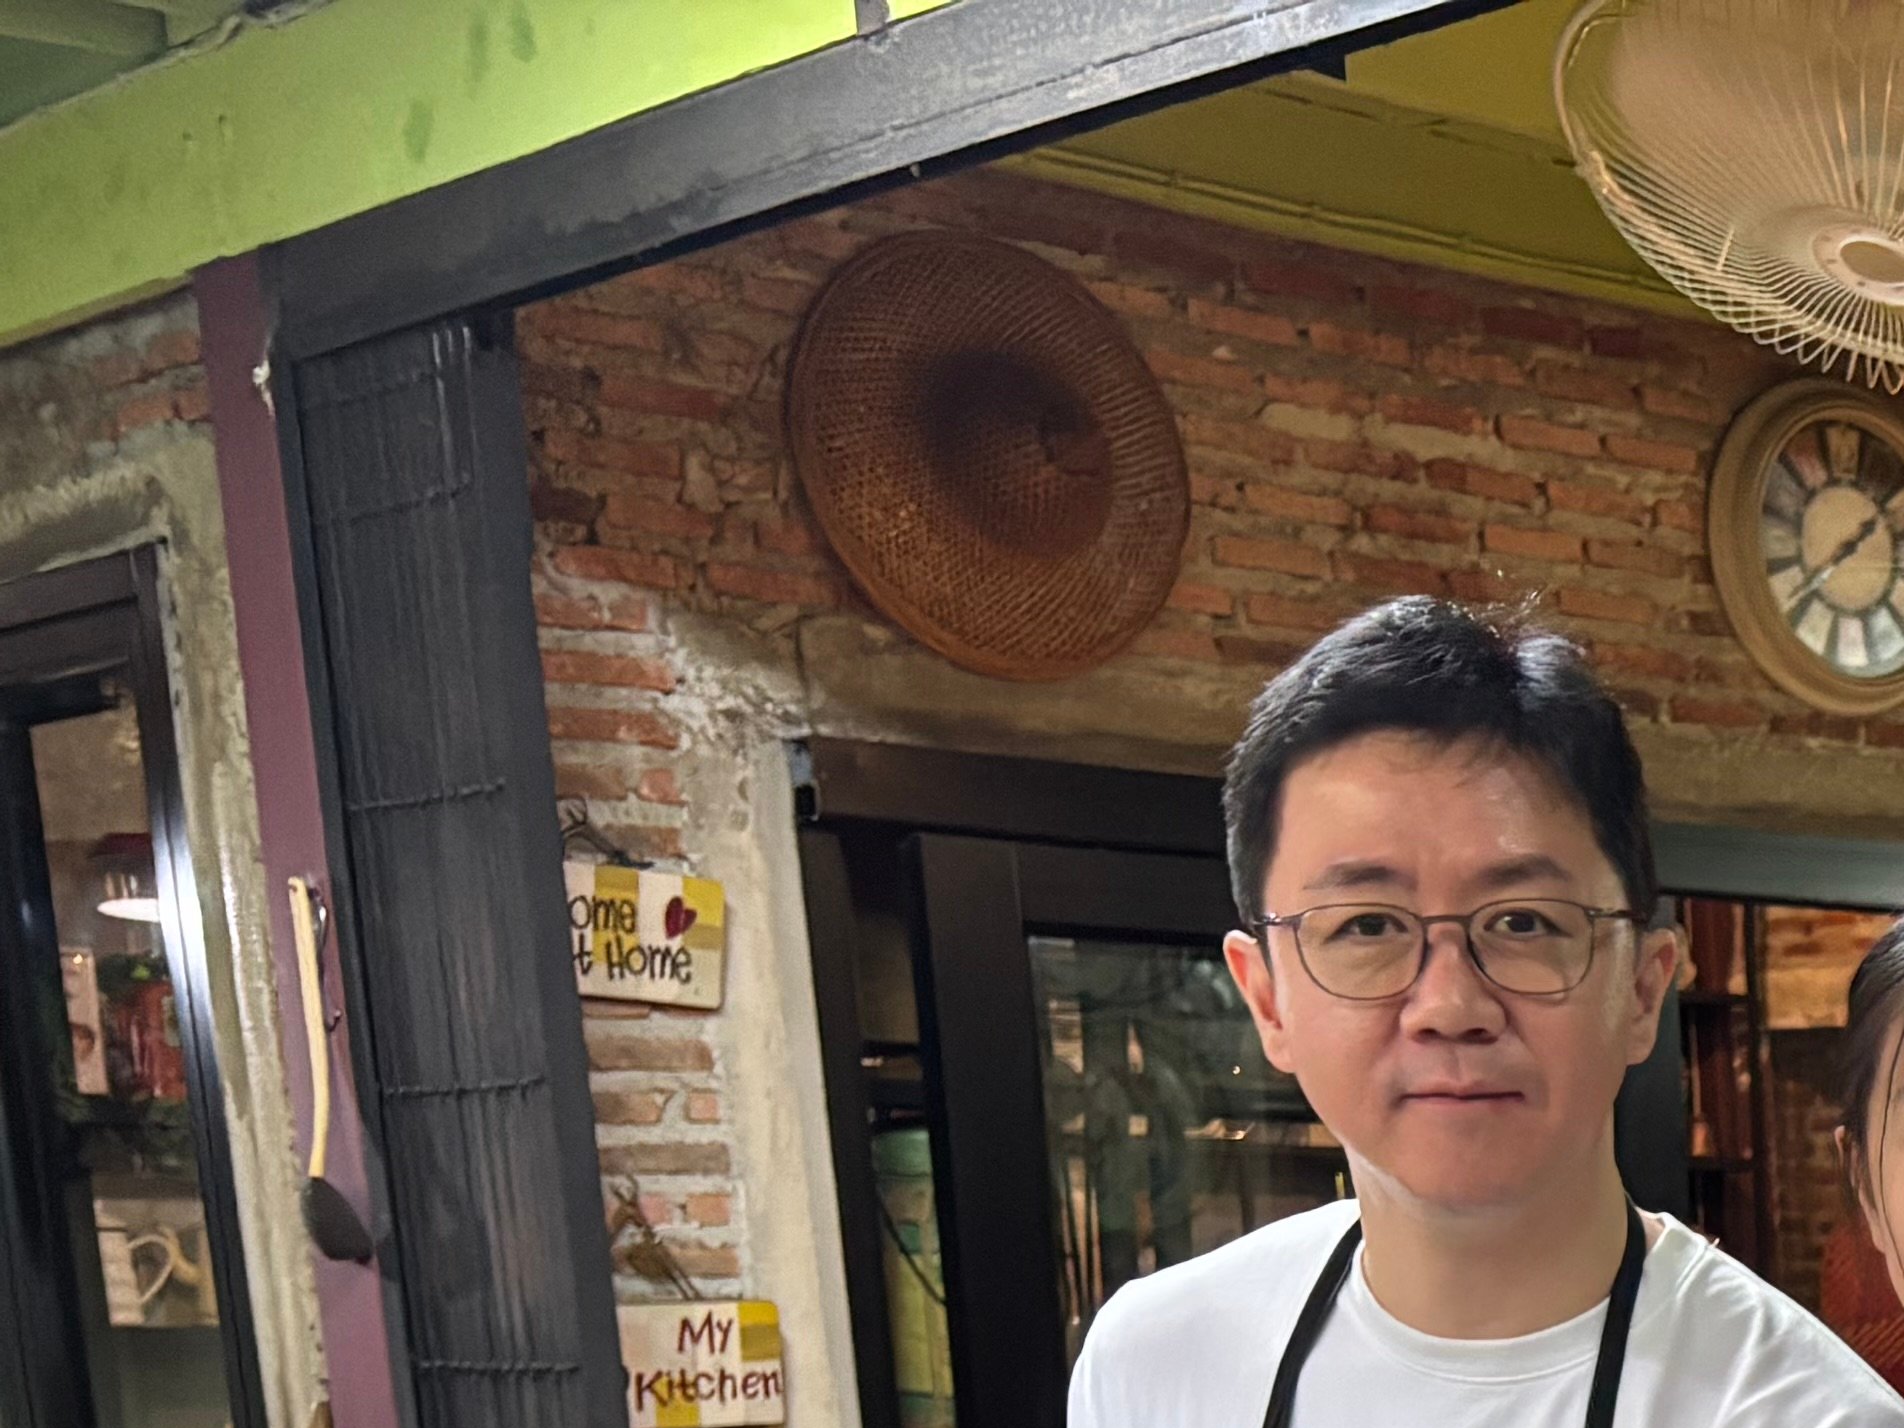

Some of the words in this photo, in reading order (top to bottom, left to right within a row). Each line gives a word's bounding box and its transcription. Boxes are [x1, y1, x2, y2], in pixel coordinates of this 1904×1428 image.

[569, 895, 636, 934] ome
[573, 932, 593, 976] t
[605, 934, 693, 985] Home
[677, 1309, 734, 1355] My
[634, 1367, 785, 1413] Kitchen
